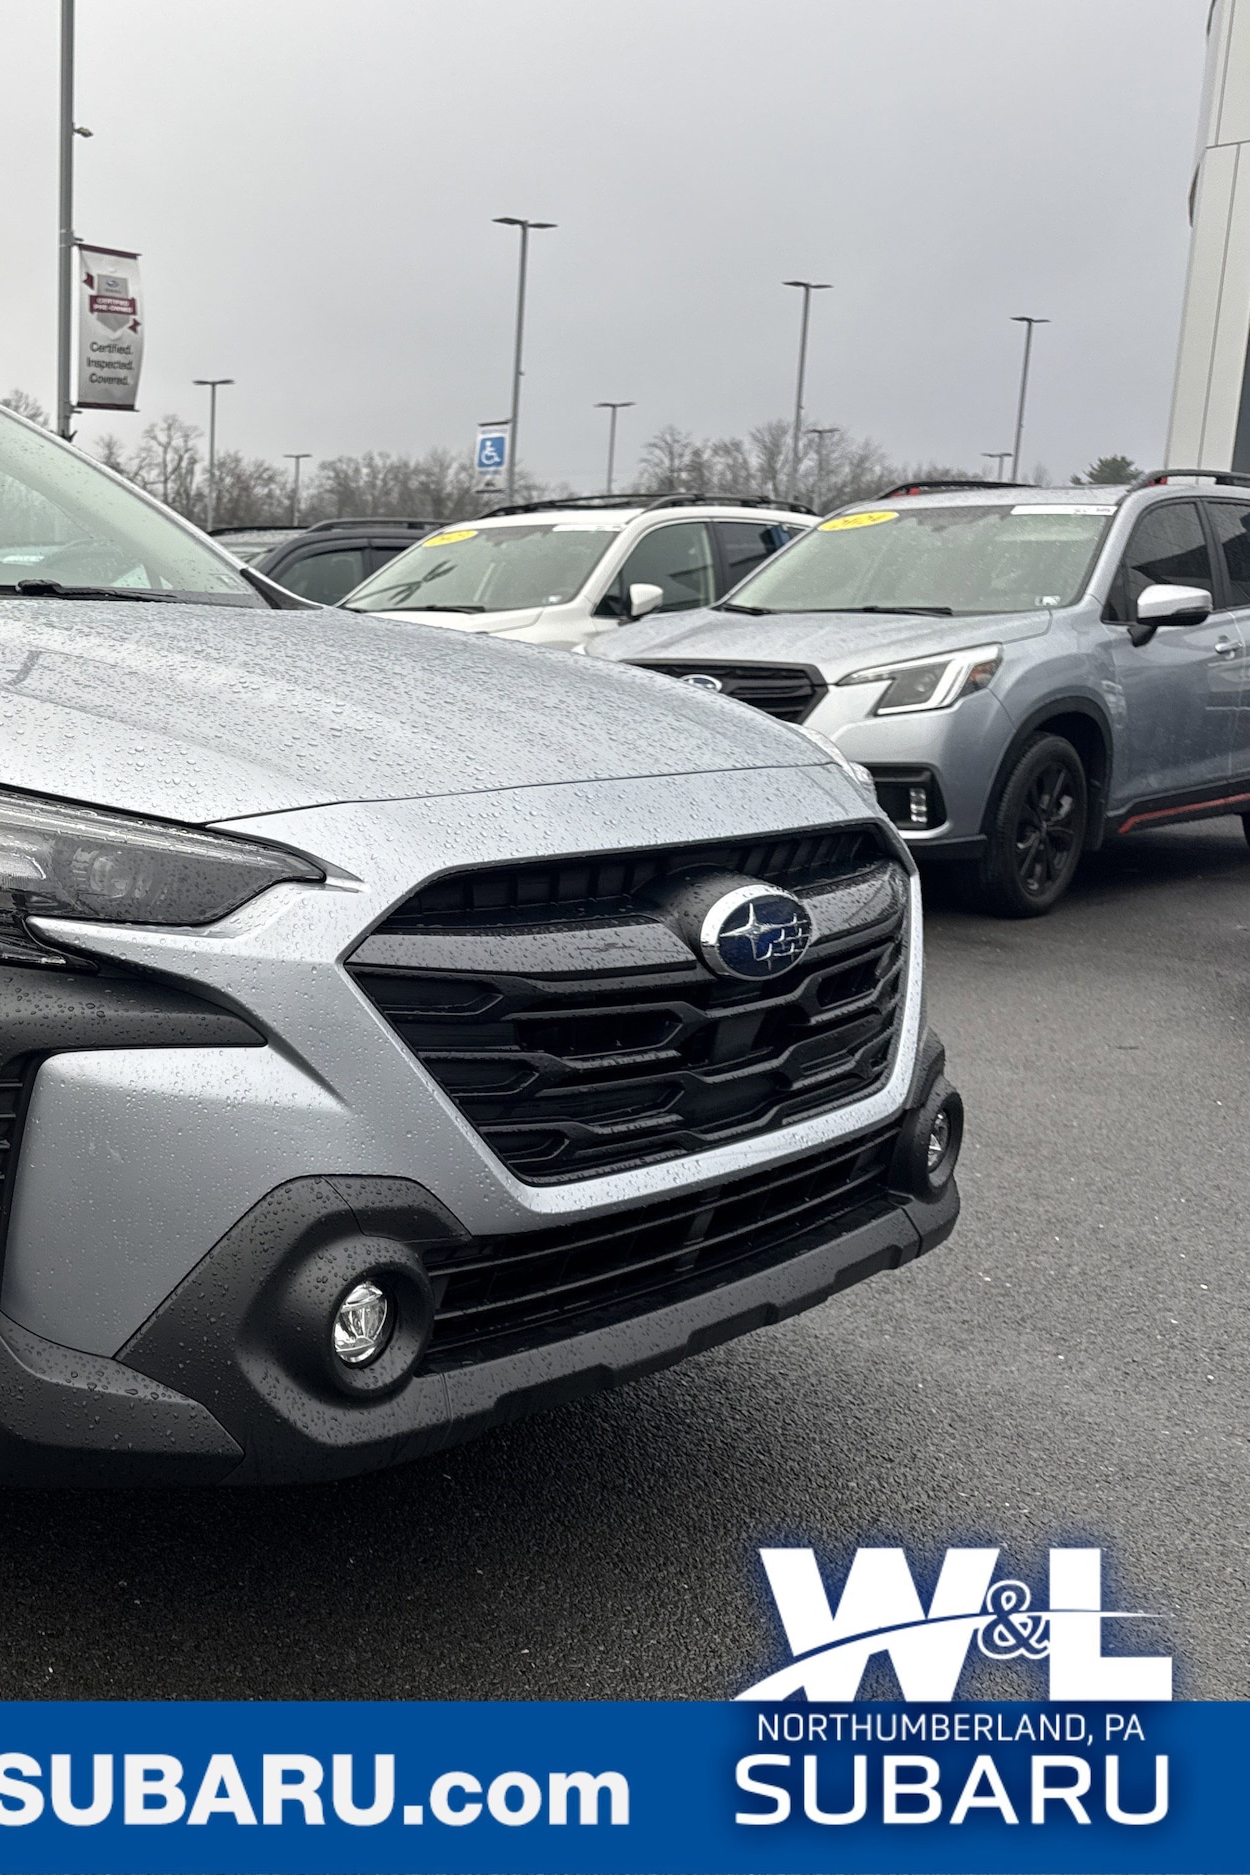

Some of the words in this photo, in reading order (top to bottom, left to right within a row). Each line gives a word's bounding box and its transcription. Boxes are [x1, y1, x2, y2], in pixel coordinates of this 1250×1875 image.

[89, 341, 134, 355] Certified.
[86, 357, 135, 371] Inspected.
[89, 373, 130, 386] Covered.
